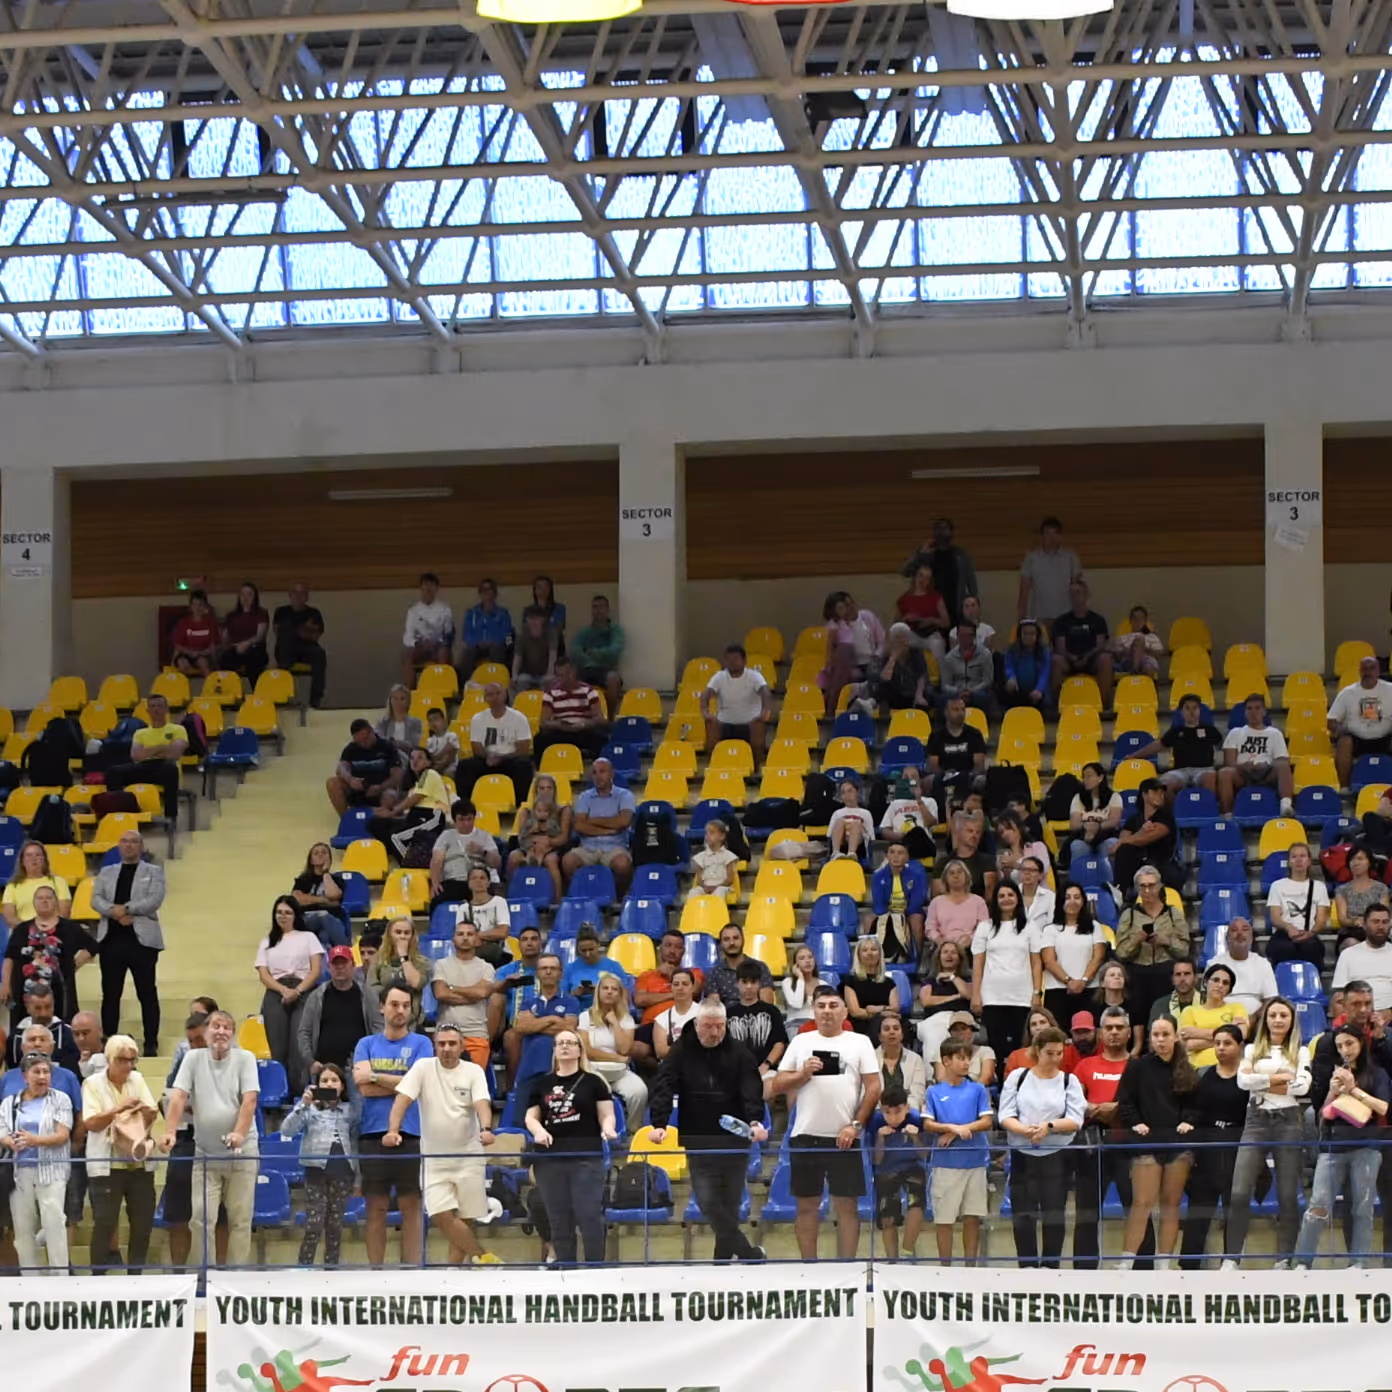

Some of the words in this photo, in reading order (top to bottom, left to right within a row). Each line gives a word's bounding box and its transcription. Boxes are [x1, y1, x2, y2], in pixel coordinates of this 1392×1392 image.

[1267, 490, 1320, 503] SECTOR
[622, 507, 673, 520] SECTOR
[1289, 506, 1299, 521] 3
[642, 523, 652, 537] 3
[2, 533, 51, 547] SECTOR
[21, 548, 31, 561] 4
[215, 1293, 305, 1325] YOUTH
[310, 1294, 517, 1326] INTERNATIONAL
[524, 1292, 665, 1323] HANDBALL
[671, 1287, 858, 1322] TOURNAMENT
[882, 1290, 975, 1322] YOUTH
[981, 1292, 1197, 1324] INTERNATIONAL
[1204, 1293, 1349, 1324] HANDBALL
[9, 1299, 188, 1330] TOURNAMENT
[379, 1345, 470, 1381] fun
[1052, 1343, 1147, 1380] fun
